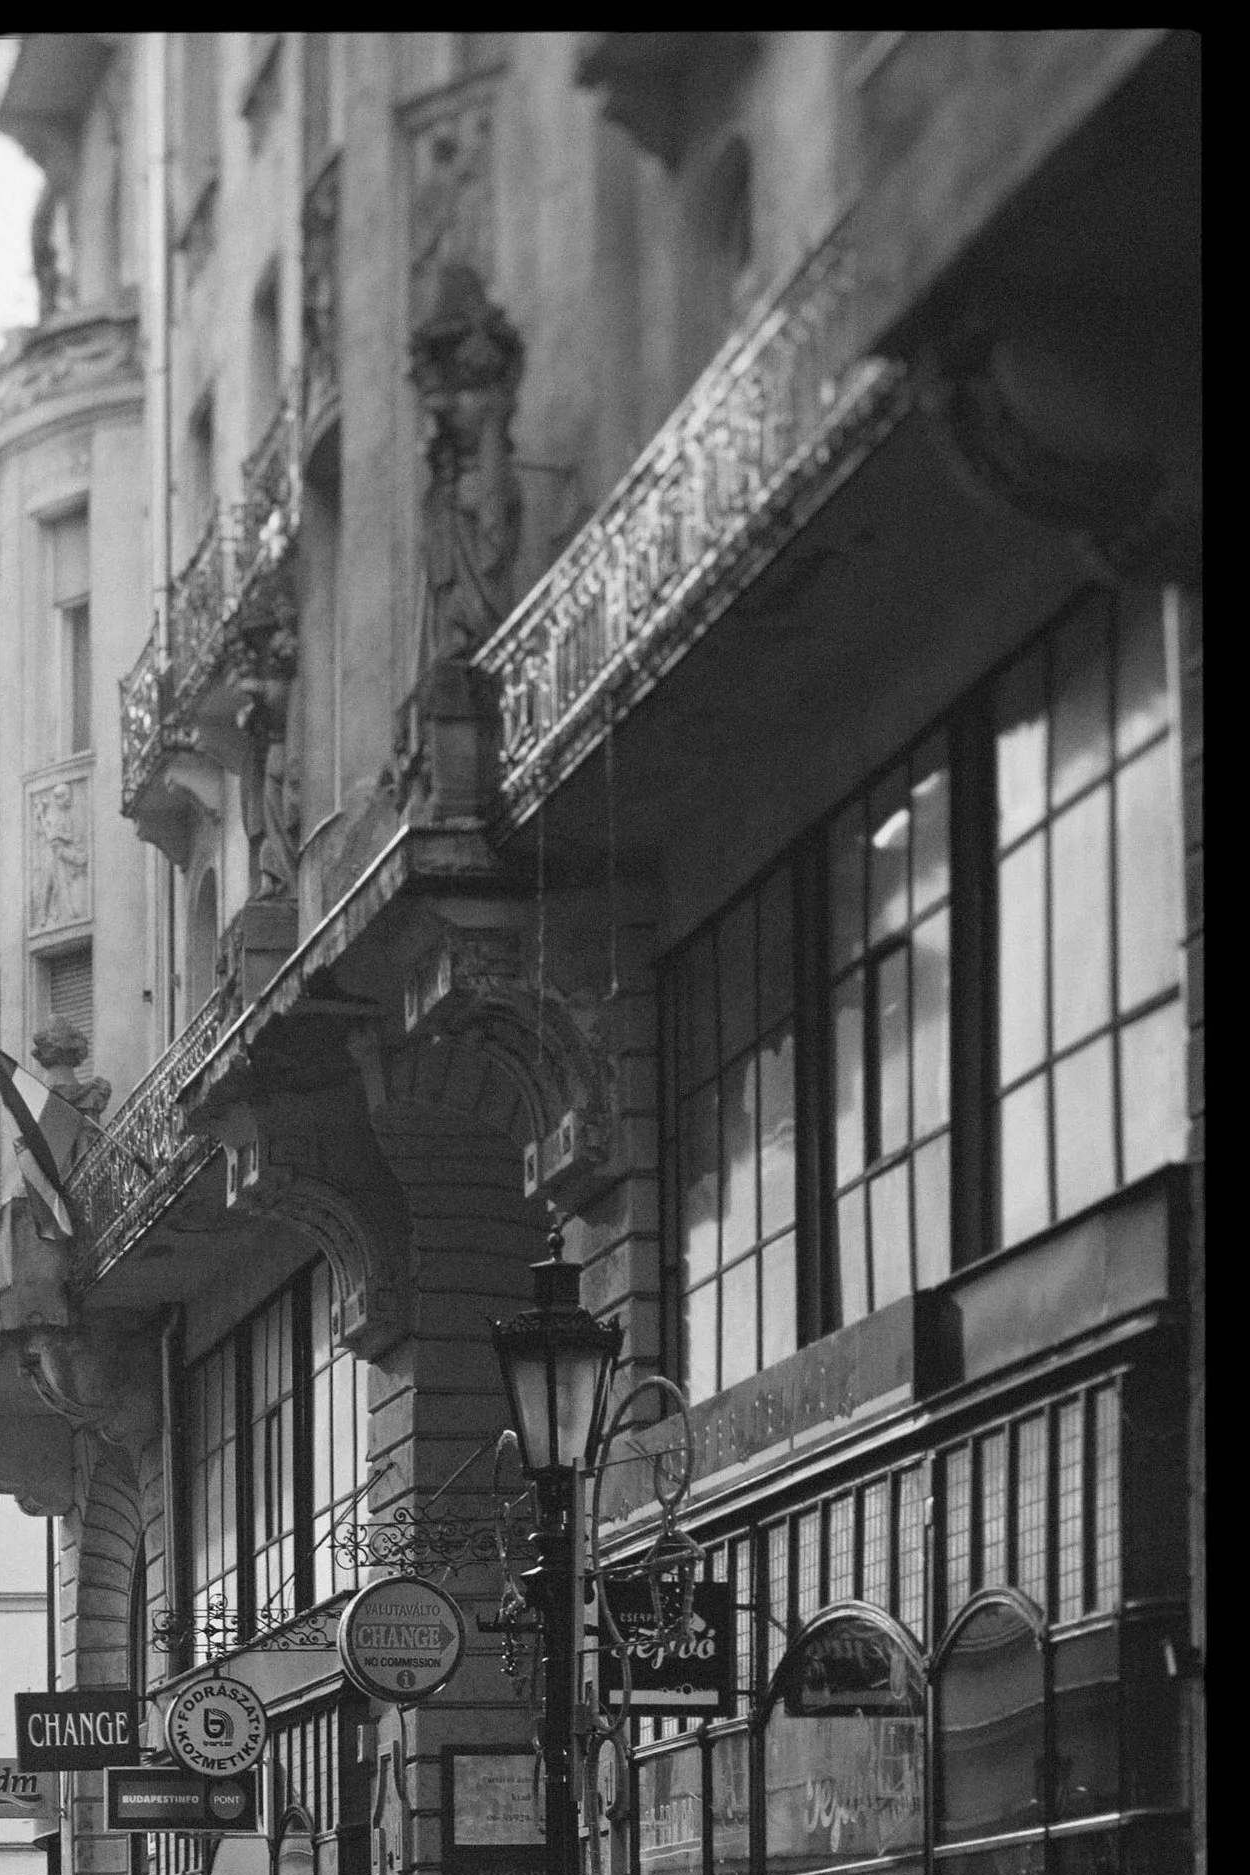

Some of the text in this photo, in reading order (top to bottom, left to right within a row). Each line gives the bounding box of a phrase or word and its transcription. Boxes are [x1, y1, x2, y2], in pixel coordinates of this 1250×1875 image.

[358, 1625, 440, 1648] CHANGE
[365, 1657, 441, 1668] NO COMMISSION
[177, 1682, 261, 1725] FODRÁSZAT
[28, 1711, 130, 1747] CHANGE
[176, 1730, 260, 1770] KOZMETIKA
[122, 1795, 239, 1804] BUDAPESTINFO PONT
